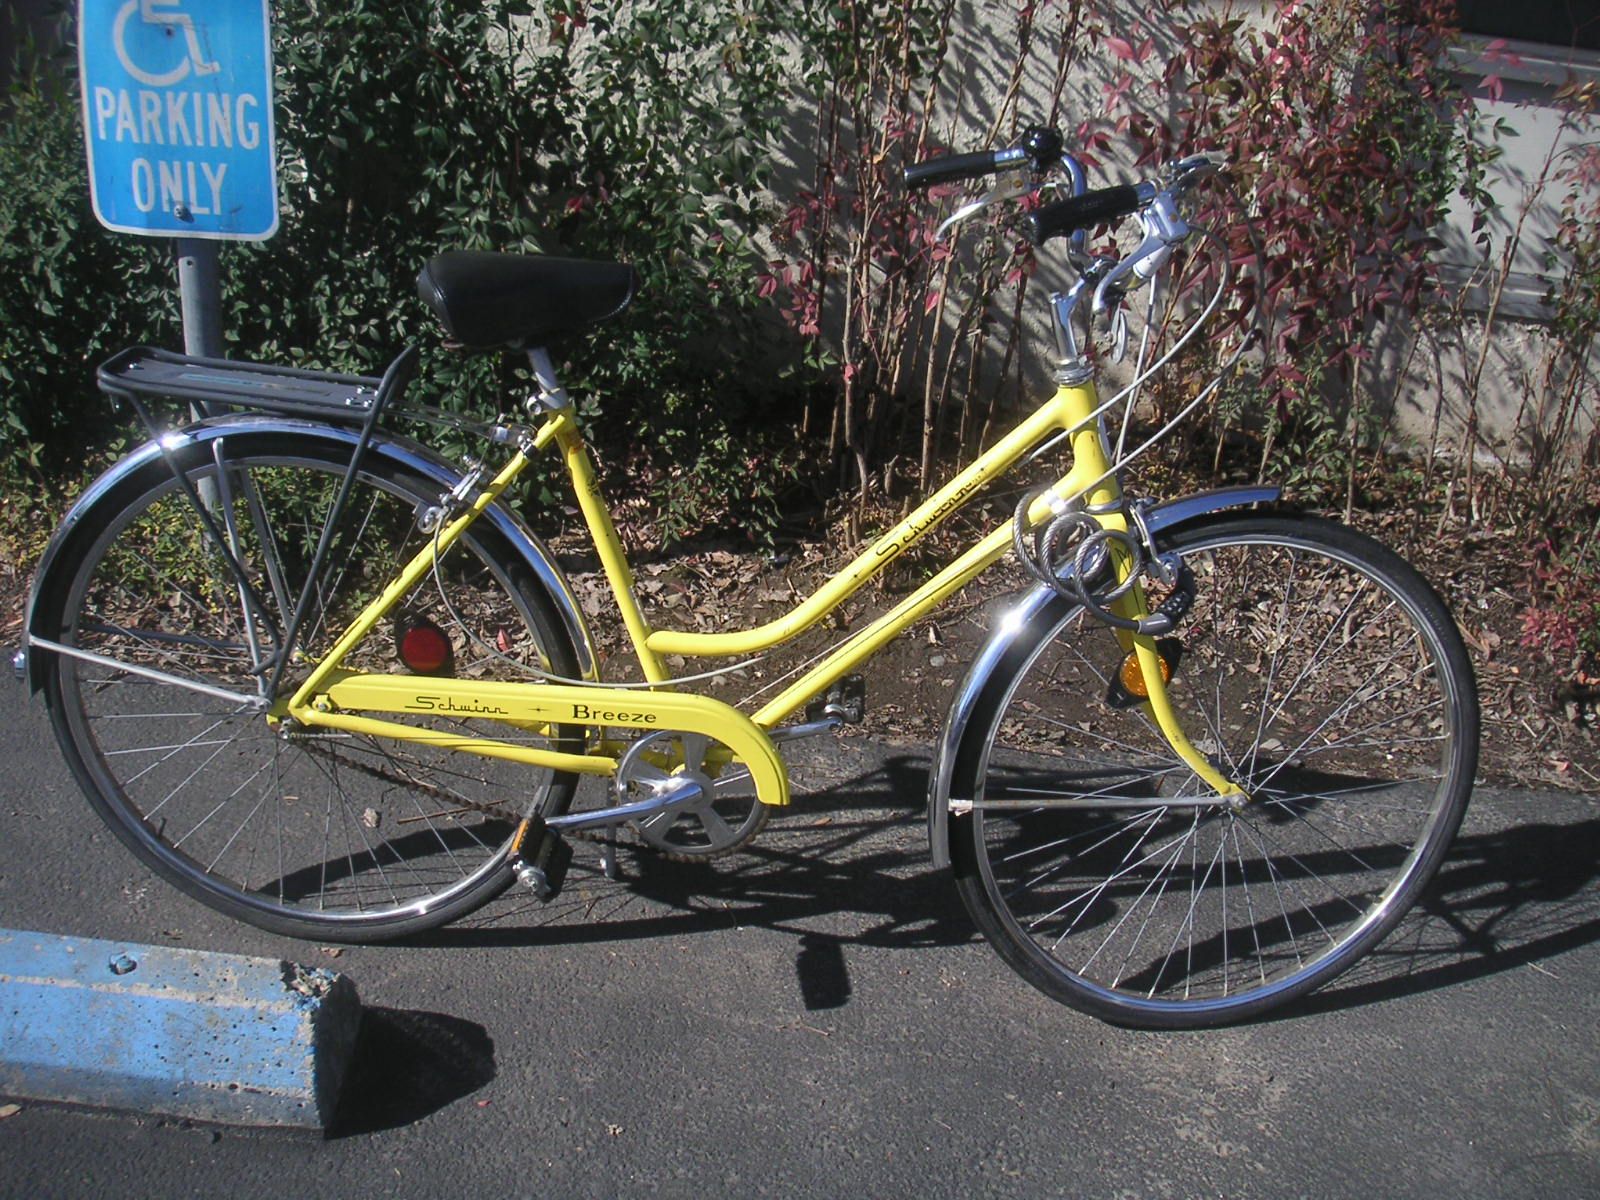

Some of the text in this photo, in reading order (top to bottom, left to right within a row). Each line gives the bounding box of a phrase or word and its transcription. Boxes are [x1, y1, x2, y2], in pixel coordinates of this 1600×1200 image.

[94, 86, 260, 150] PARKING
[131, 157, 228, 216] ONLY
[404, 696, 657, 724] Schwinn Breeze
